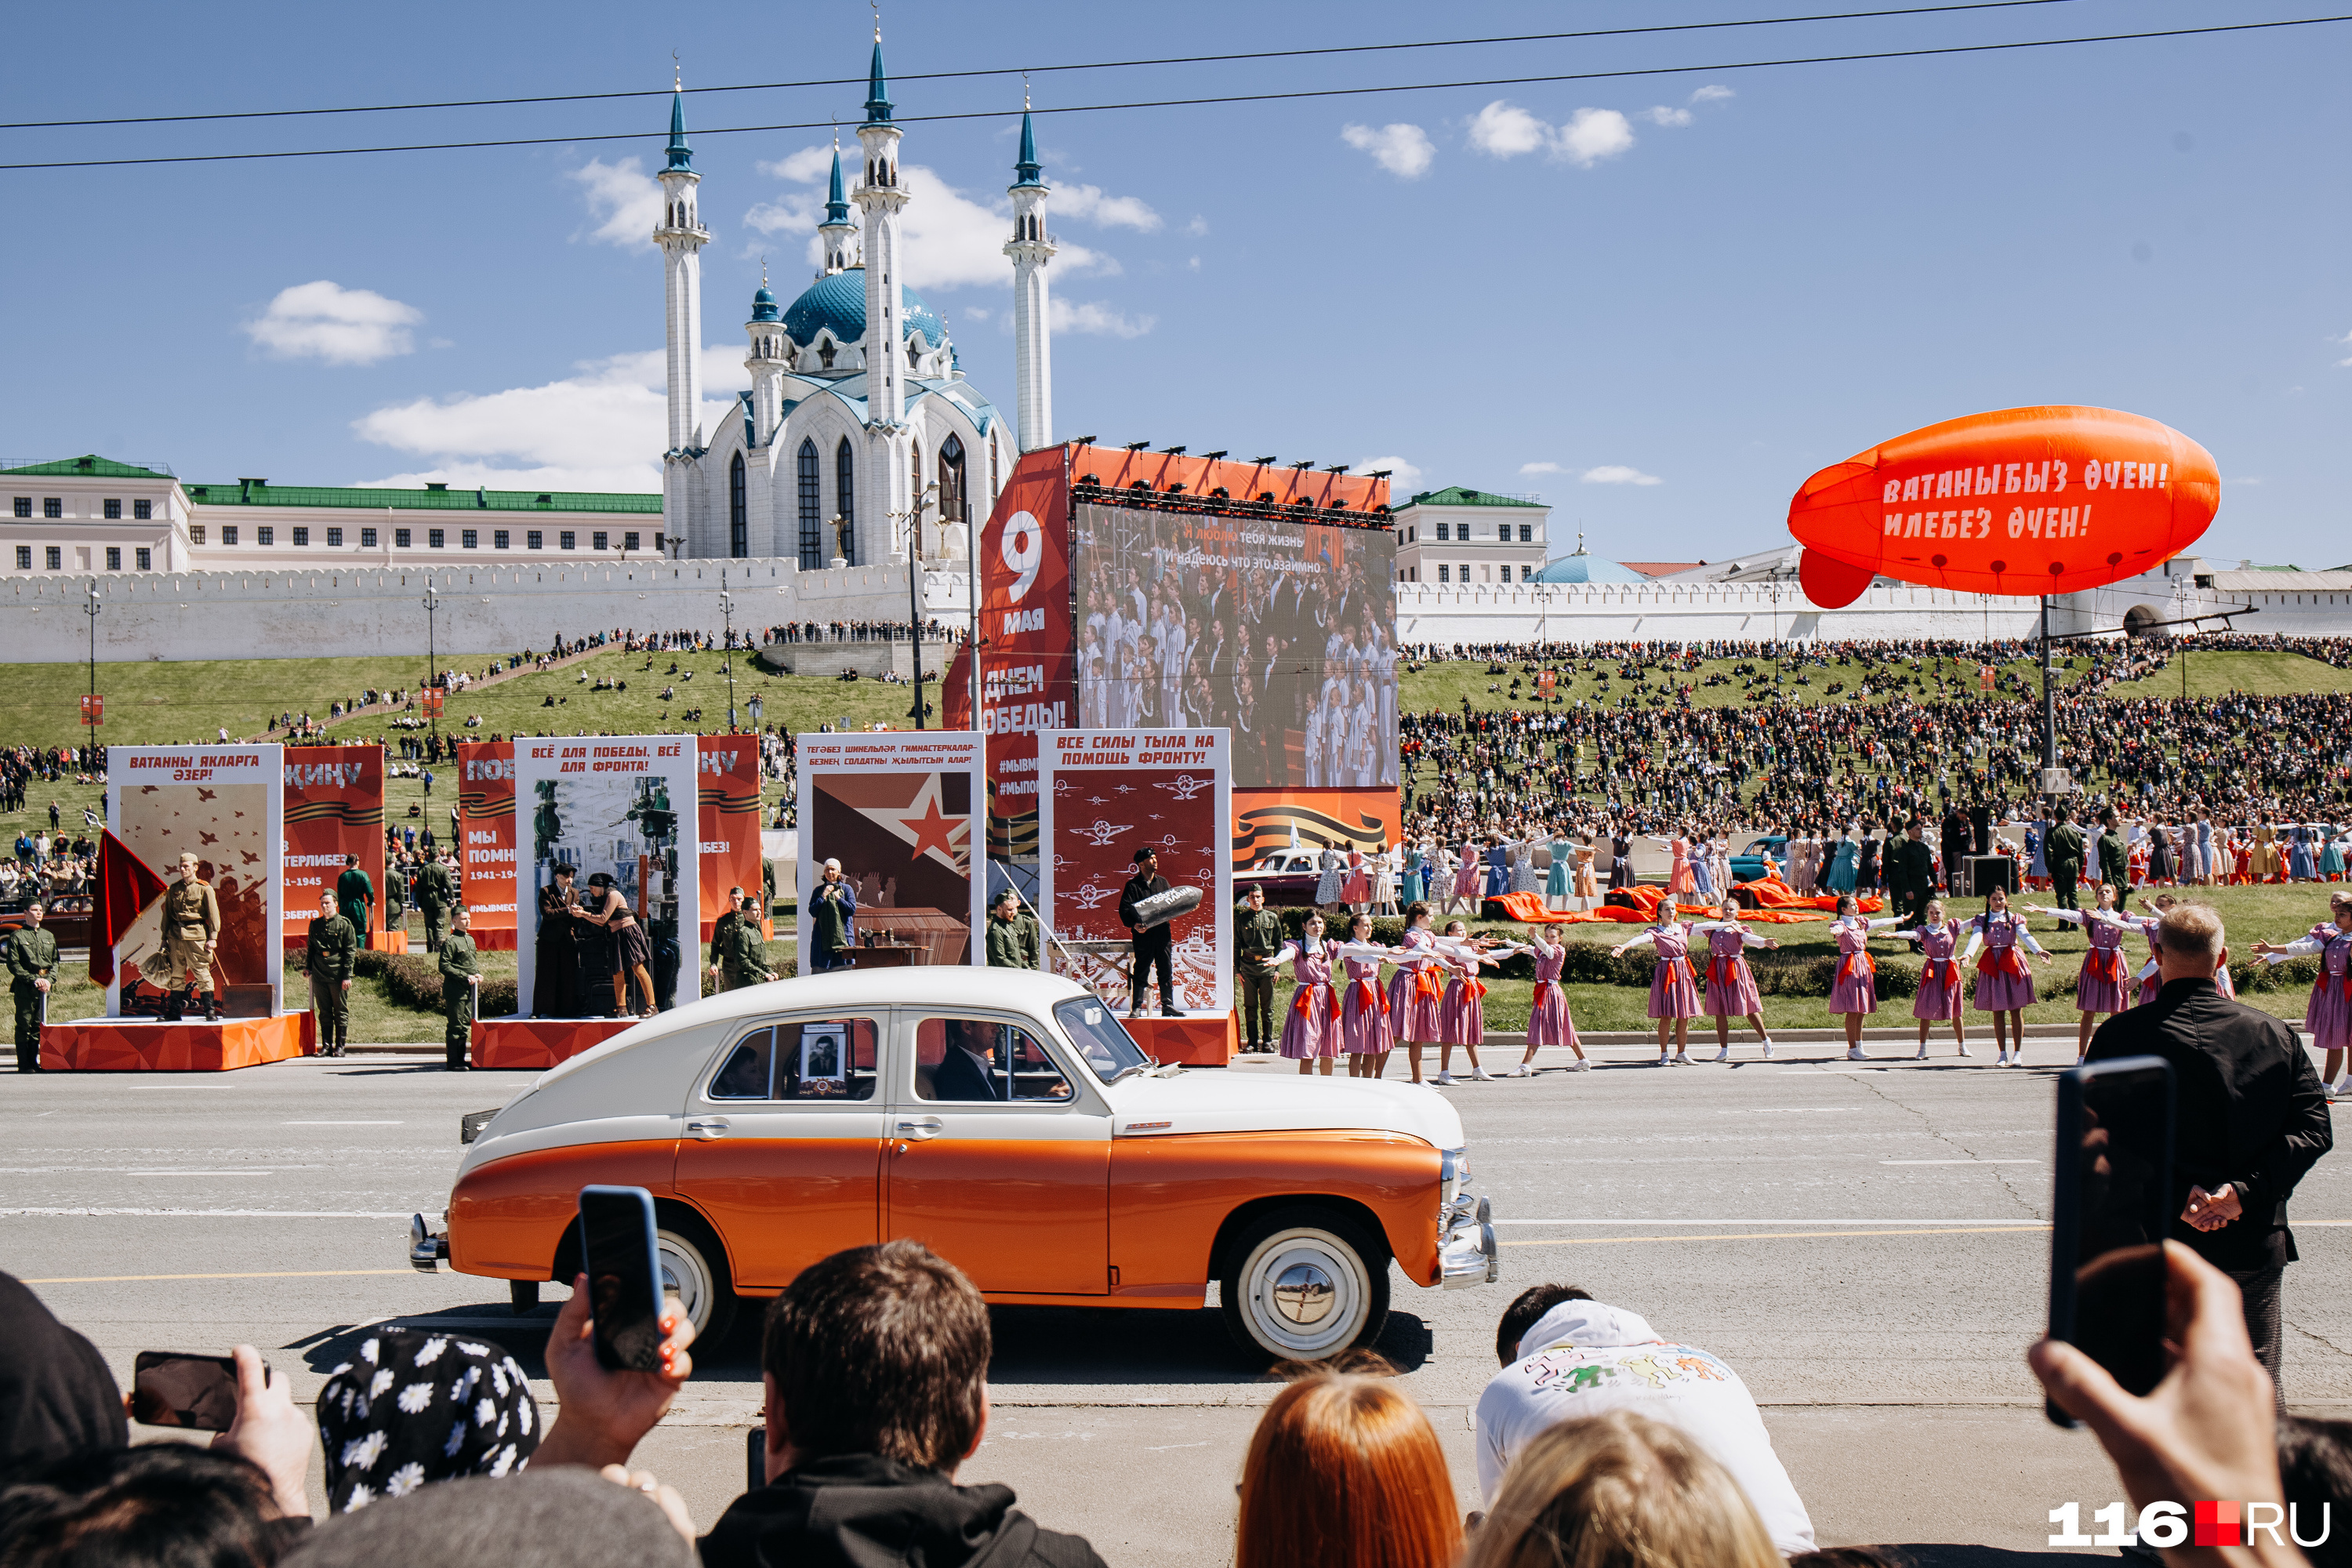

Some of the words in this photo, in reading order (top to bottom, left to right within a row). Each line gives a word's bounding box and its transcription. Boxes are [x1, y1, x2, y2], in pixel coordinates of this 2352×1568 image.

[1883, 459, 2068, 503] ВАТАНЫБЫЗ
[1884, 507, 1992, 539] ИЛЕБЕЗ
[1185, 524, 1192, 538] Я
[1196, 528, 1238, 542] люблю
[1240, 530, 1265, 545] тебя
[1268, 535, 1304, 548] жизнь
[1001, 510, 1043, 604] 9
[1165, 547, 1174, 562] И
[1178, 552, 1229, 568] надеюсь
[1231, 556, 1250, 568] что
[1253, 557, 1272, 570] это
[1273, 559, 1321, 573] взаимно
[1004, 608, 1045, 635] МАЯ
[985, 665, 1044, 703] ДНЕМ
[969, 701, 1065, 736] ОБЕДЫ!
[532, 744, 555, 758] ВСЁ
[561, 747, 586, 758] ДЛЯ
[593, 746, 650, 757] ПОБЕДЫ,
[657, 742, 681, 757] ВСЁ
[1057, 736, 1084, 749] ВСЕ
[1092, 736, 1136, 749] СИЛЫ
[1144, 735, 1186, 748] ТЫЛА
[1195, 735, 1214, 748] НА
[129, 757, 193, 768] ВАТАННЫ
[200, 755, 260, 768] ЯКЛАРГА
[999, 757, 1039, 773] #МЫВМ
[1062, 752, 1130, 764] ПОМОЩЬ
[1138, 751, 1206, 764] ФРОНТУ!
[560, 761, 586, 772] ДЛЯ
[593, 760, 649, 772] ФРОНТА!
[173, 769, 213, 781] ӘЗЕР!
[1000, 779, 1039, 795] #МЫПО
[469, 830, 496, 844] МЫ
[284, 854, 348, 867] ТЕРЛИБЕЗ
[469, 848, 517, 863] ПОМН
[284, 877, 321, 887] 1-1945
[470, 870, 517, 880] 1941-194
[1165, 887, 1193, 905] ПЛАНА
[470, 903, 517, 913] #МЫВМЕСТ
